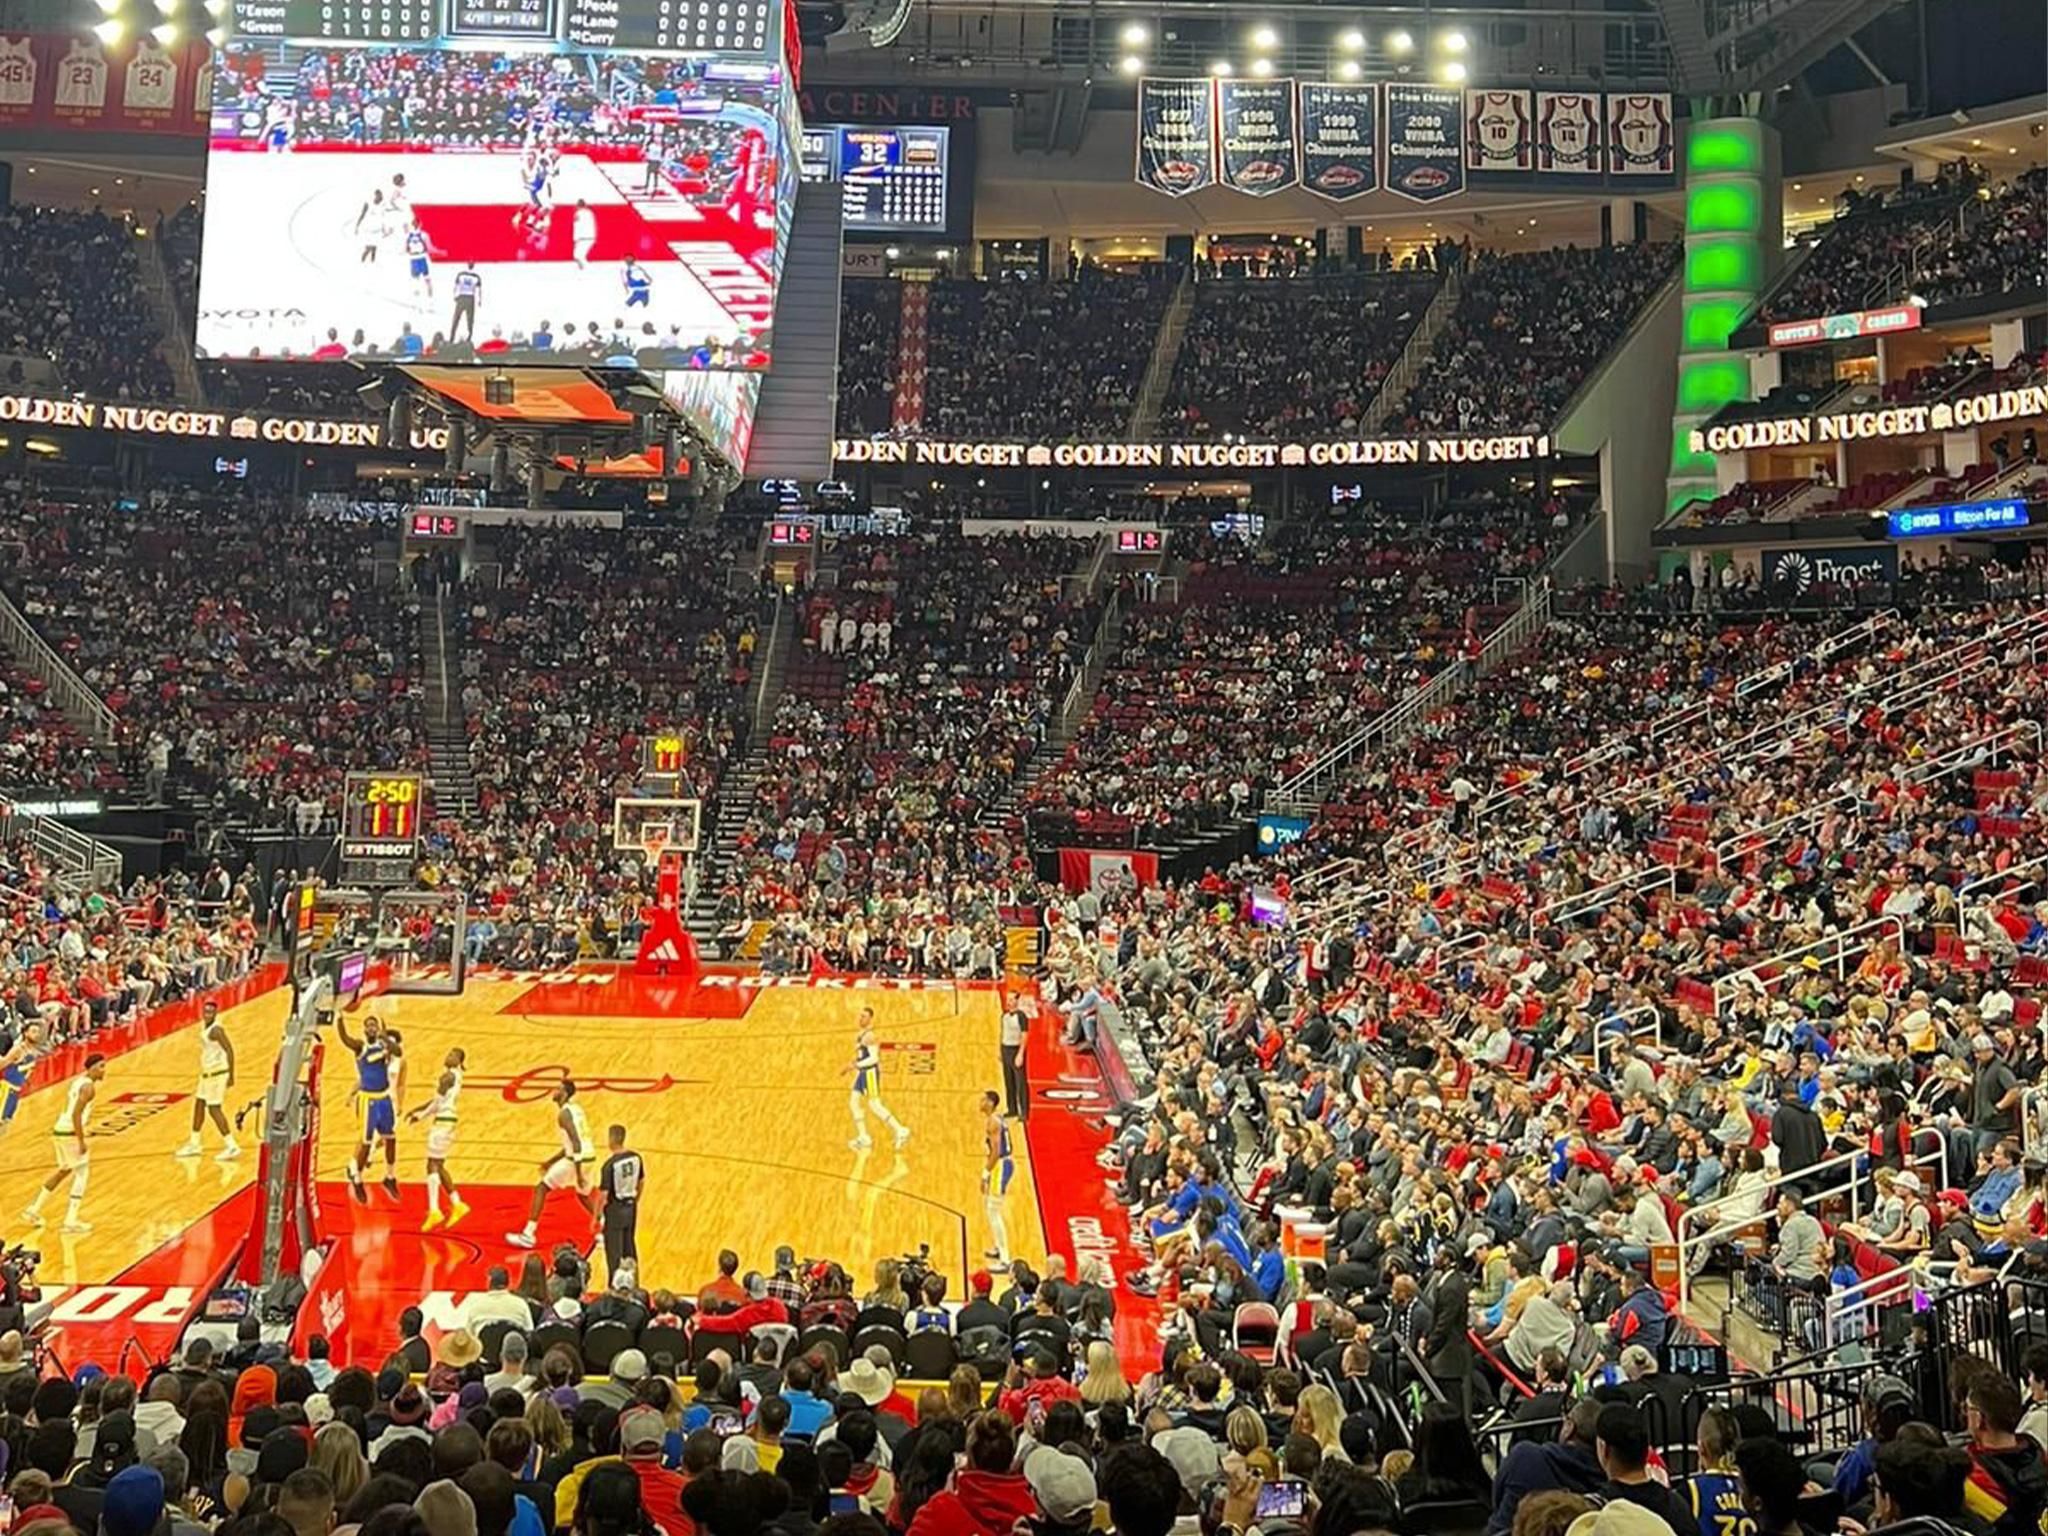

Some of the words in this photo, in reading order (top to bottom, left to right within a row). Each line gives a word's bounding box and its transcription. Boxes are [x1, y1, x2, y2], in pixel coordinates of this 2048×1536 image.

[322, 6, 332, 19] 0
[342, 7, 350, 20] 1
[361, 8, 371, 21] 0
[381, 8, 391, 21] 0
[401, 9, 410, 22] 0
[421, 9, 430, 22] 0
[660, 1, 670, 14] 0
[680, 2, 689, 15] 0
[699, 2, 709, 15] 0
[718, 3, 728, 16] 0
[738, 4, 747, 17] 0
[757, 4, 767, 17] 0
[246, 20, 284, 33] Green
[322, 22, 331, 35] 2
[342, 23, 350, 36] 1
[362, 23, 370, 36] 1
[381, 24, 391, 37] 0
[401, 25, 410, 37] 0
[420, 25, 430, 38] 0
[582, 15, 619, 28] Lamb
[659, 17, 668, 30] 0
[678, 18, 688, 31] 0
[697, 19, 707, 31] 0
[717, 19, 726, 32] 0
[736, 20, 745, 33] 0
[755, 20, 765, 33] 0
[581, 31, 615, 46] Curry
[658, 33, 667, 46] 0
[677, 33, 686, 46] 0
[696, 34, 705, 47] 6
[715, 35, 724, 48] 0
[734, 35, 744, 48] 0
[753, 36, 763, 49] 0
[72, 66, 93, 85] 23
[138, 68, 162, 87] 24
[1407, 115, 1442, 129] 2000
[1318, 128, 1360, 142] WNBA
[1404, 129, 1446, 142] WNBA
[1491, 126, 1507, 140] 10
[860, 143, 888, 163] 32
[1225, 138, 1292, 154] Champions
[1305, 142, 1373, 159] Champions
[1390, 143, 1460, 160] Champions
[1953, 384, 2048, 426] GOLDEN
[103, 406, 225, 437] NUGGET
[1707, 416, 1811, 452] GOLDEN
[1818, 405, 1929, 442] NUGGET
[261, 417, 380, 447] GOLDEN
[916, 441, 1025, 467] NUGGET
[1053, 443, 1163, 467] GOLDEN
[1171, 443, 1279, 467] NUGGET
[1309, 440, 1420, 466] GOLDEN
[1427, 435, 1535, 463] NUGGET
[1986, 506, 2001, 521] For
[1814, 557, 1884, 587] Frost
[367, 780, 413, 803] 2:50
[372, 804, 406, 836] 11
[1276, 827, 1303, 843] PN
